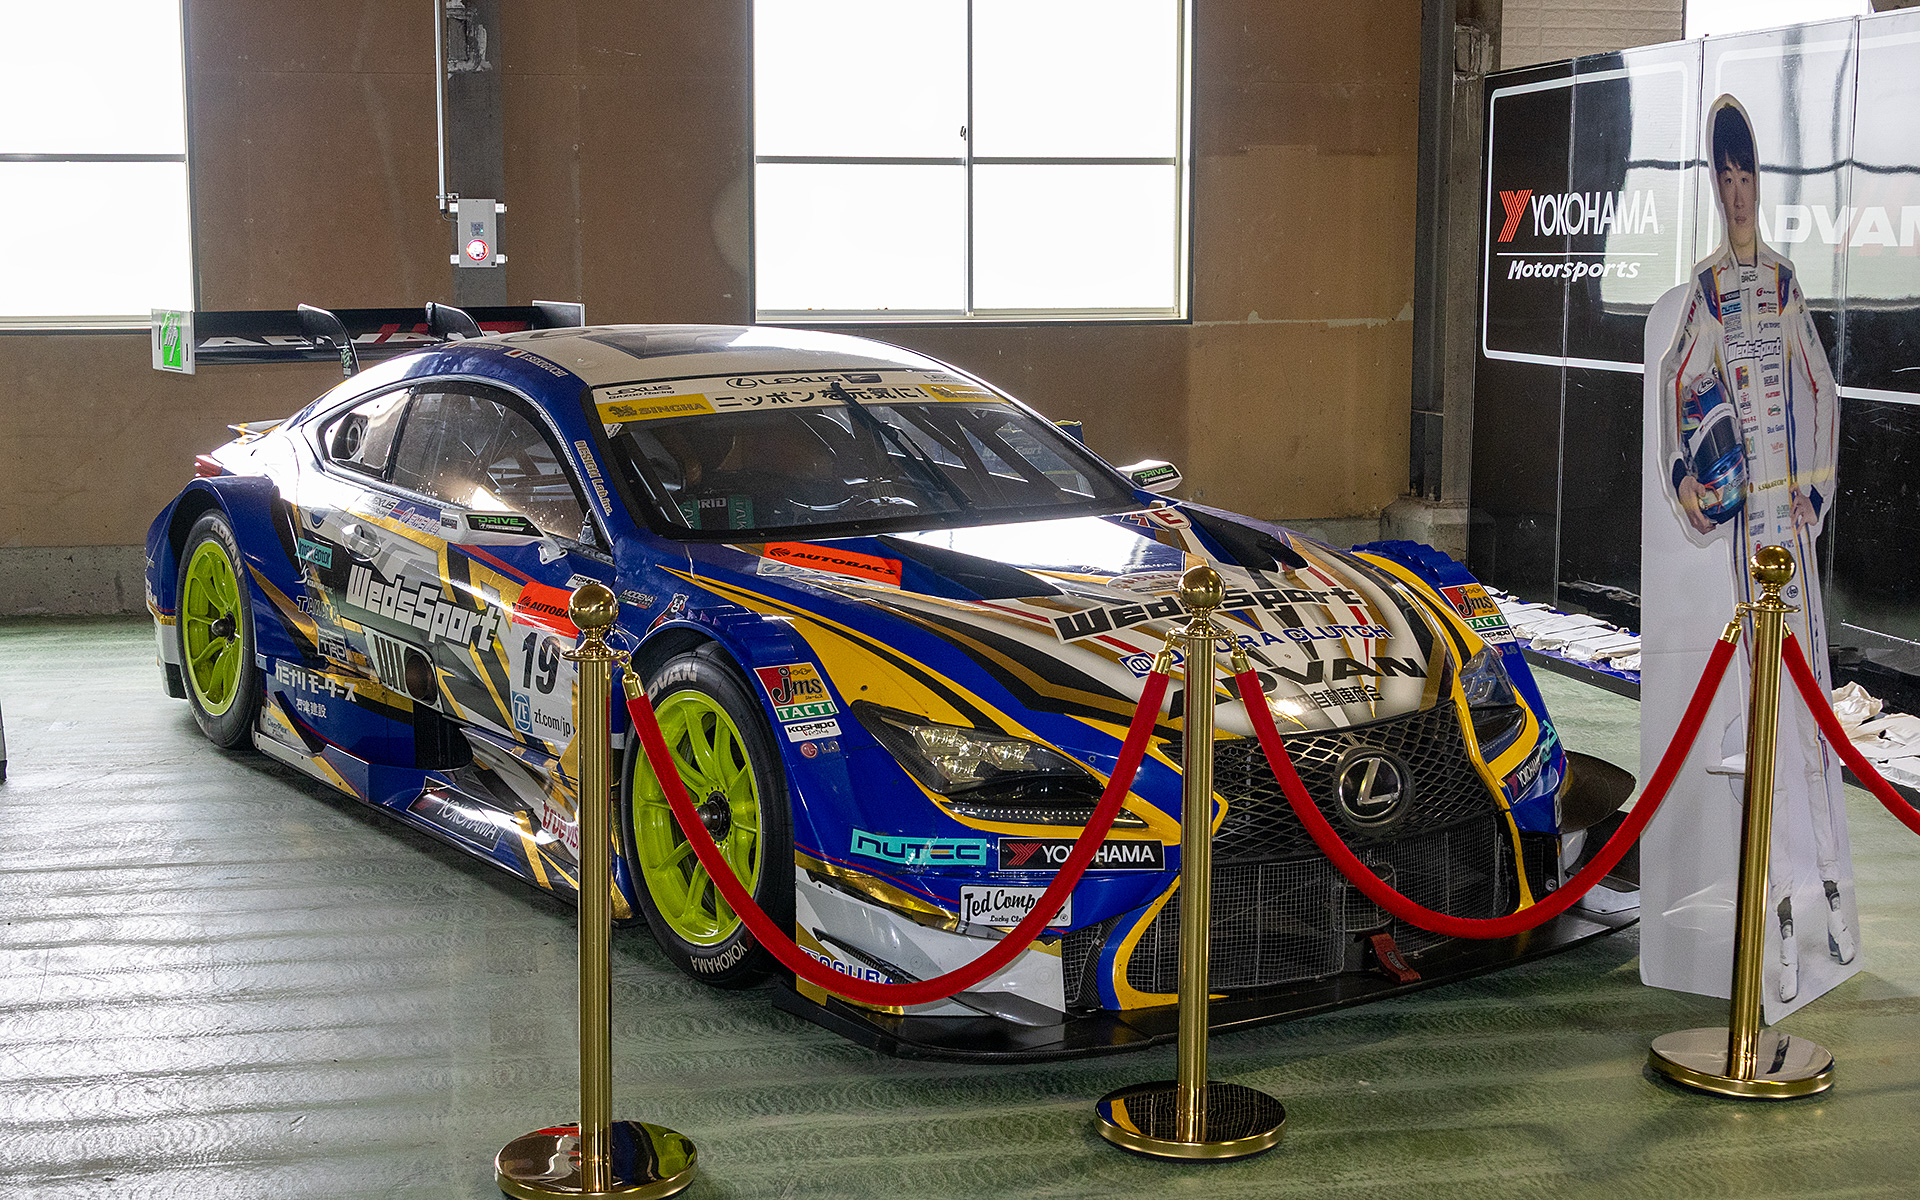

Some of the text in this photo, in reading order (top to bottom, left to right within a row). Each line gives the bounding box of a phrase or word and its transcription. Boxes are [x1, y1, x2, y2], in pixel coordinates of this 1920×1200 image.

[1531, 190, 1659, 236] YOKOHAMA
[1759, 205, 1920, 247] DVA
[1507, 260, 1641, 282] Motorsports
[605, 384, 673, 396] LEXUS
[757, 374, 841, 385] LEXUS
[638, 403, 707, 415] SINGHA
[574, 440, 602, 480] DESIGN
[1135, 468, 1173, 478] DRIVE
[698, 497, 727, 509] RID
[472, 516, 526, 526] DRIVE
[210, 519, 245, 578] ADVAN
[791, 552, 898, 576] AUTOBACS
[346, 564, 502, 651] WedsSport
[529, 601, 570, 619] AUTOBA
[1456, 586, 1494, 617] jms
[1054, 587, 1363, 641] WedSport
[1466, 616, 1506, 629] TACTI
[1282, 624, 1394, 643] CLUTCH
[522, 632, 561, 694] 19
[647, 661, 698, 702] DVAN
[771, 666, 823, 704] jms
[515, 701, 531, 723] ZF
[778, 702, 836, 719] TACTI
[534, 708, 571, 738] zf.com/jp
[787, 721, 836, 733] KOSHIDO
[820, 740, 841, 754] LG
[857, 836, 981, 860] NUTEC
[1042, 845, 1155, 864] YOHAMA
[963, 890, 992, 922] Ted
[690, 940, 748, 975] YOKOHAMA
